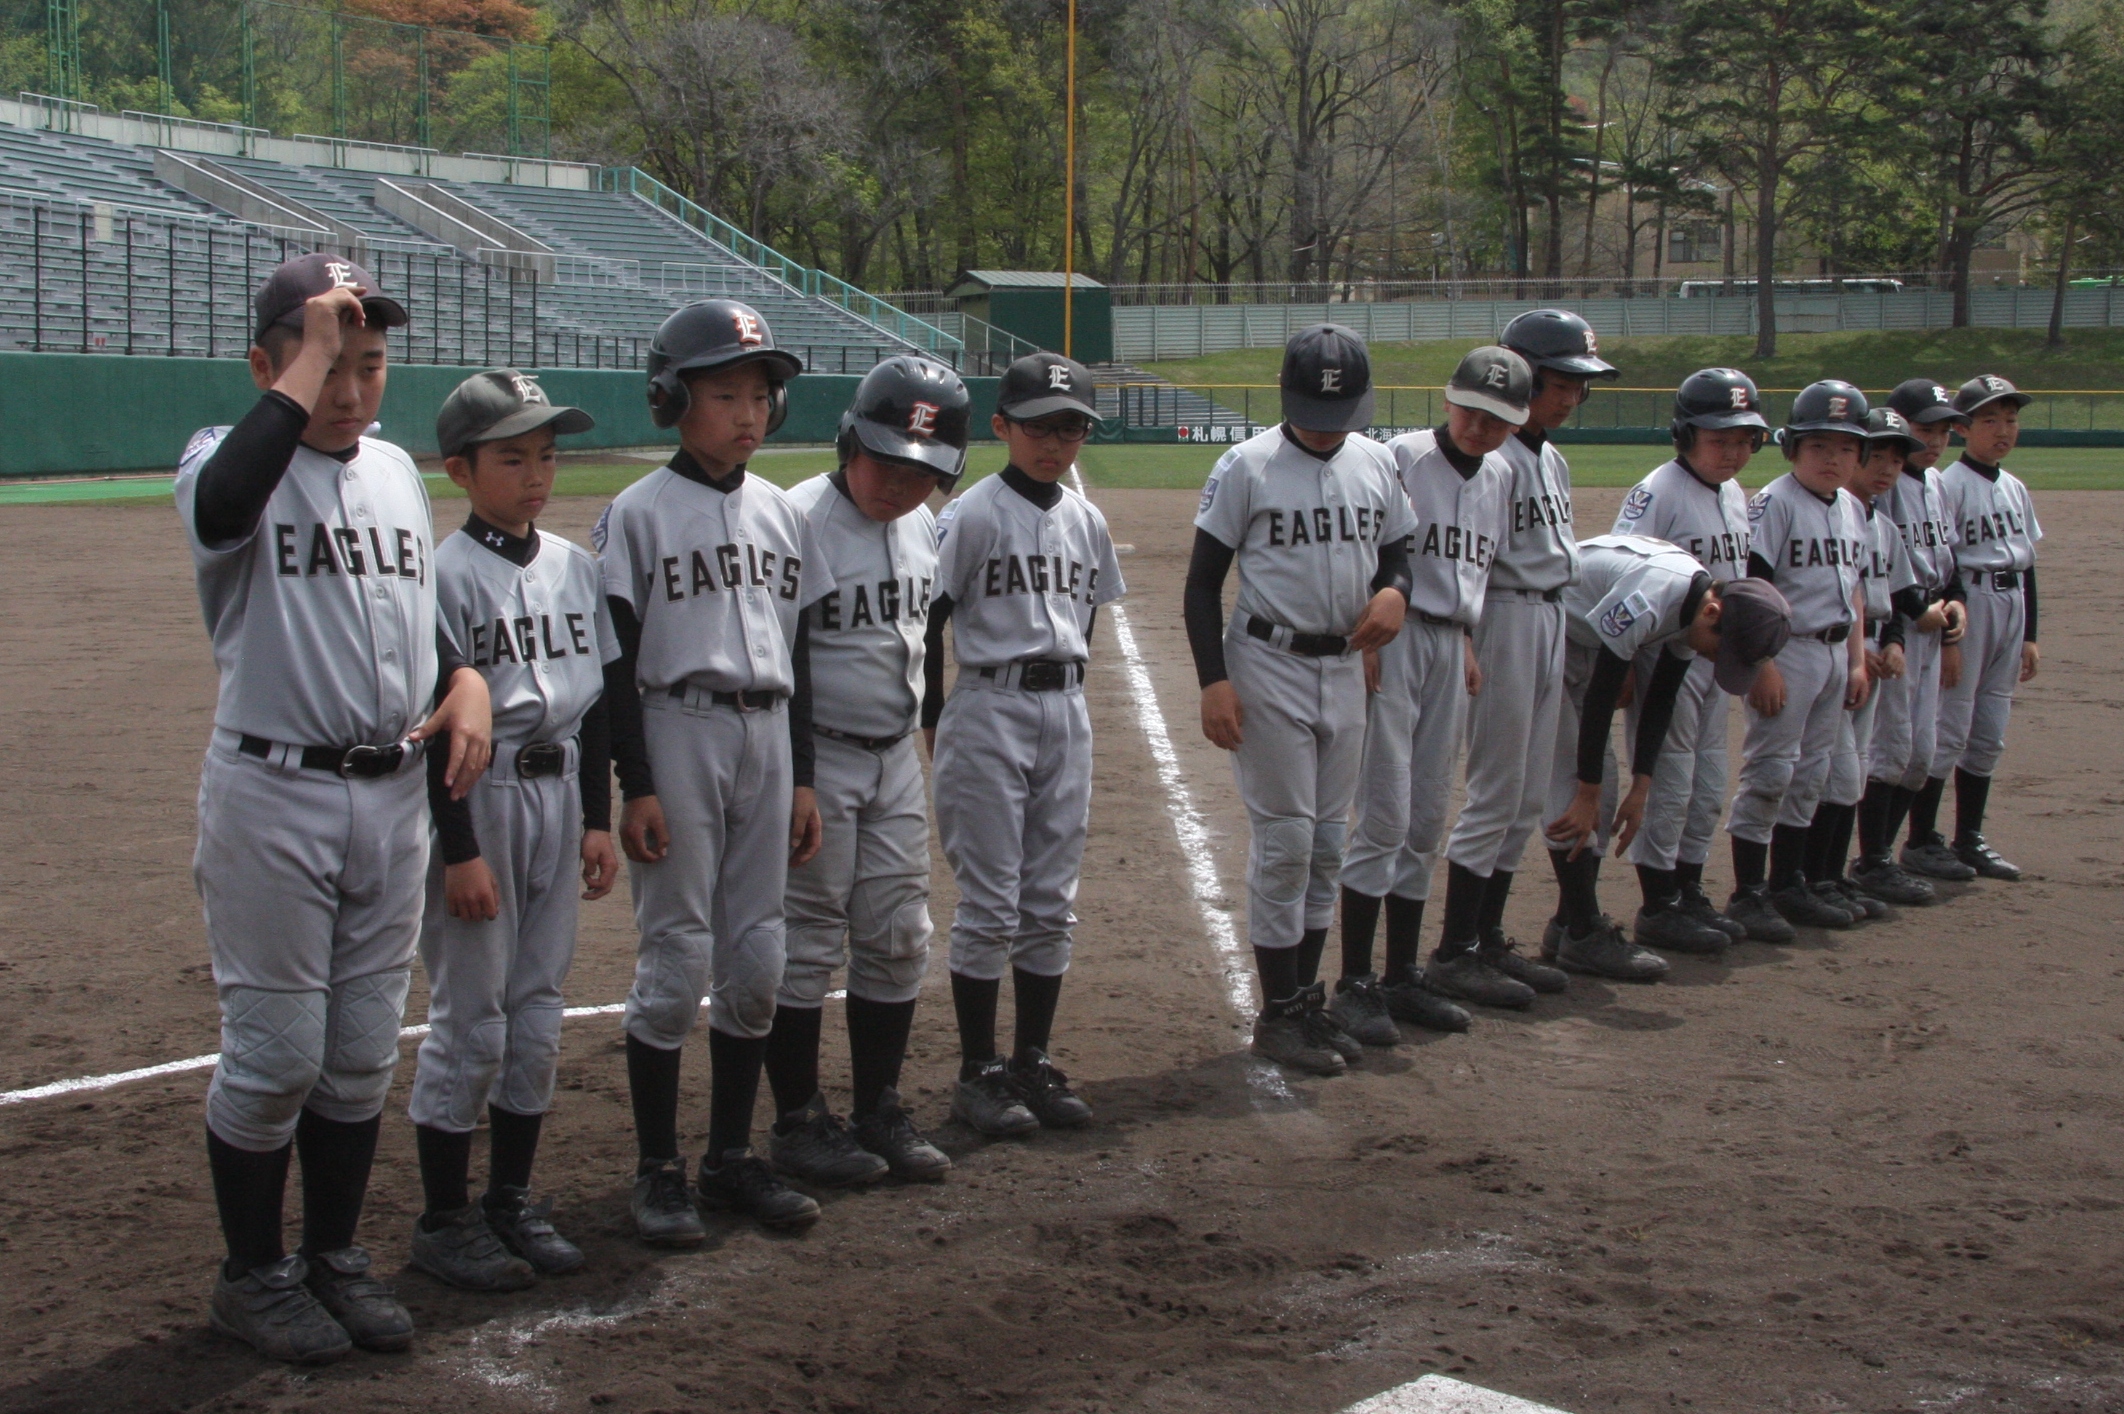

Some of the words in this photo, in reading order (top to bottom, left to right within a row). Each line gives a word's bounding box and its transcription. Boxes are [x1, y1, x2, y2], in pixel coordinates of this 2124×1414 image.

[324, 262, 358, 288] E
[731, 309, 763, 345] E
[1048, 364, 1072, 391] E
[1321, 368, 1343, 393] E
[1486, 364, 1509, 388] E
[1986, 376, 2005, 392] E
[512, 375, 541, 403] E
[1730, 387, 1748, 409] E
[1932, 386, 1949, 403] E
[908, 401, 940, 437] E
[1828, 397, 1847, 419] E
[1885, 411, 1901, 428] E
[1269, 506, 1386, 547] EAGLES
[662, 542, 801, 603] EAGLES
